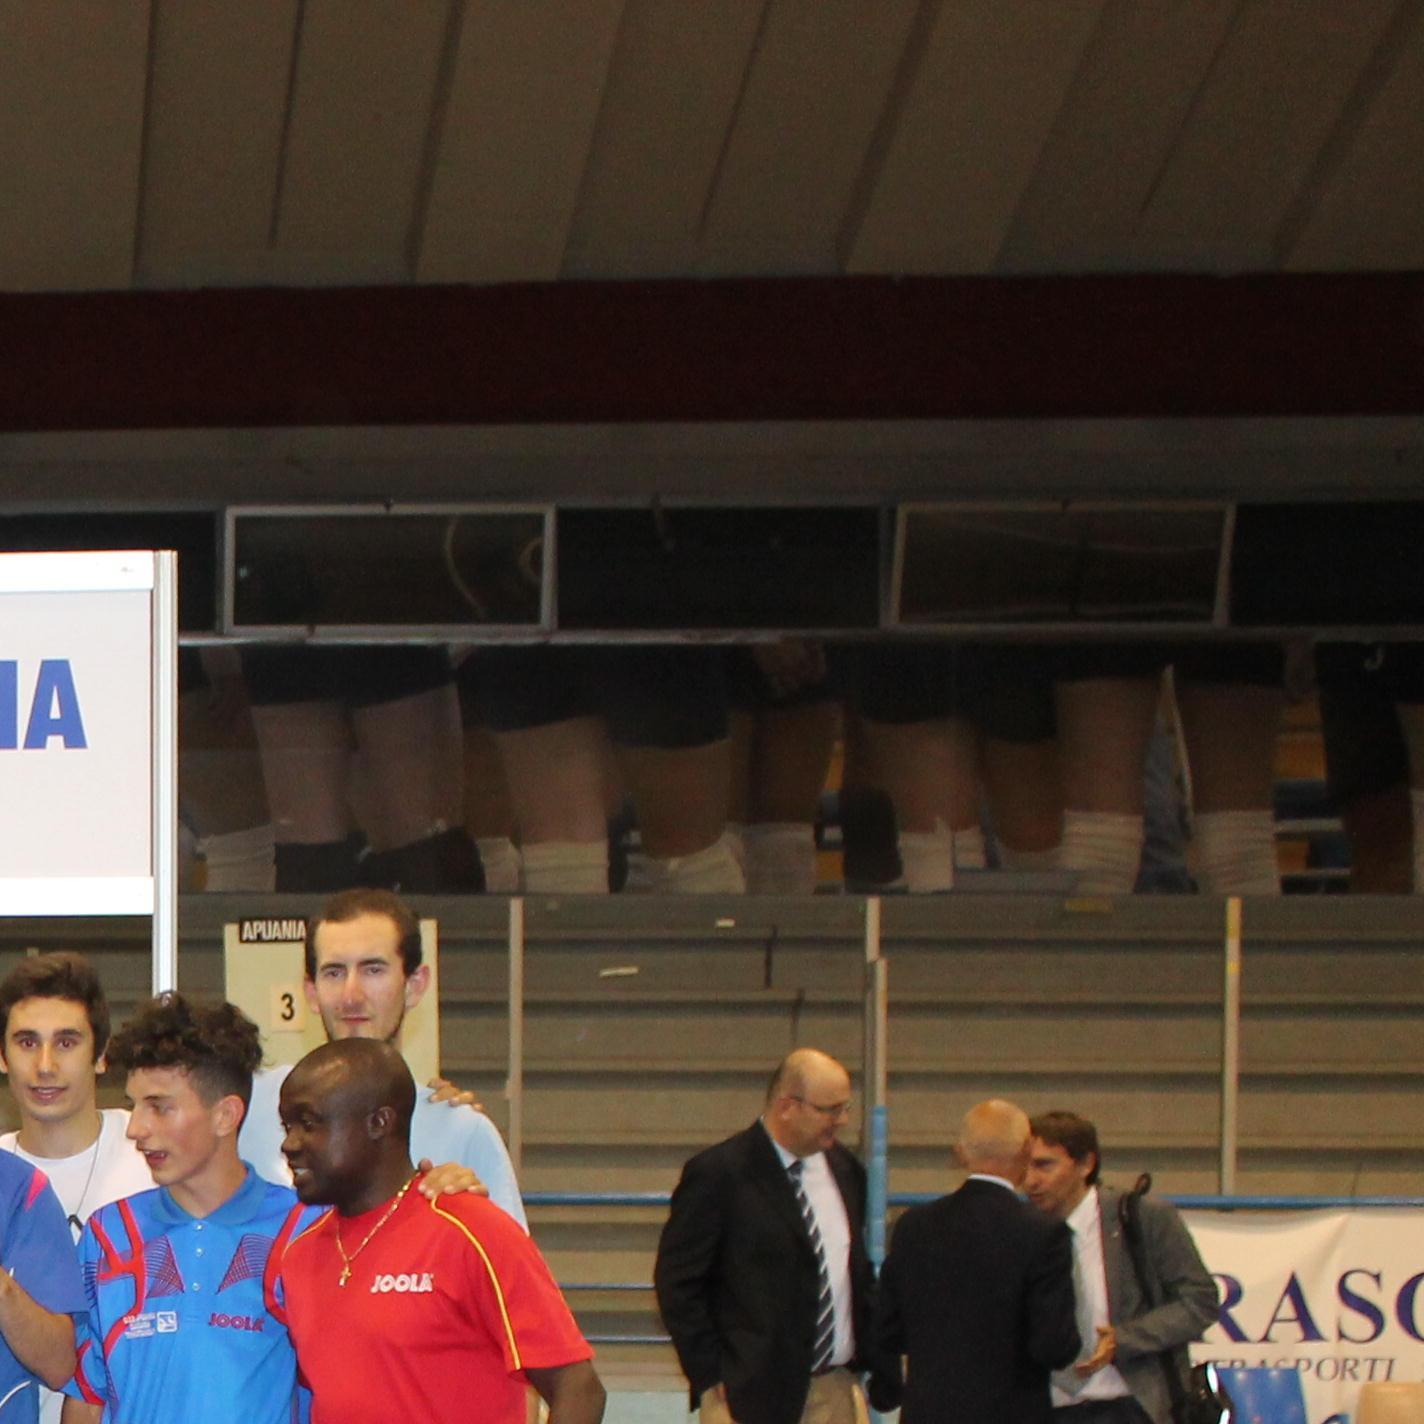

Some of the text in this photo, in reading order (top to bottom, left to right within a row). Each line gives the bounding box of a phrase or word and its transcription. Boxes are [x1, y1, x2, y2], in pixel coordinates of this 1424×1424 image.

[242, 919, 307, 941] APUANIA
[279, 992, 295, 1021] 3
[370, 1272, 434, 1294] JOOLA
[208, 1312, 265, 1332] JOOLA
